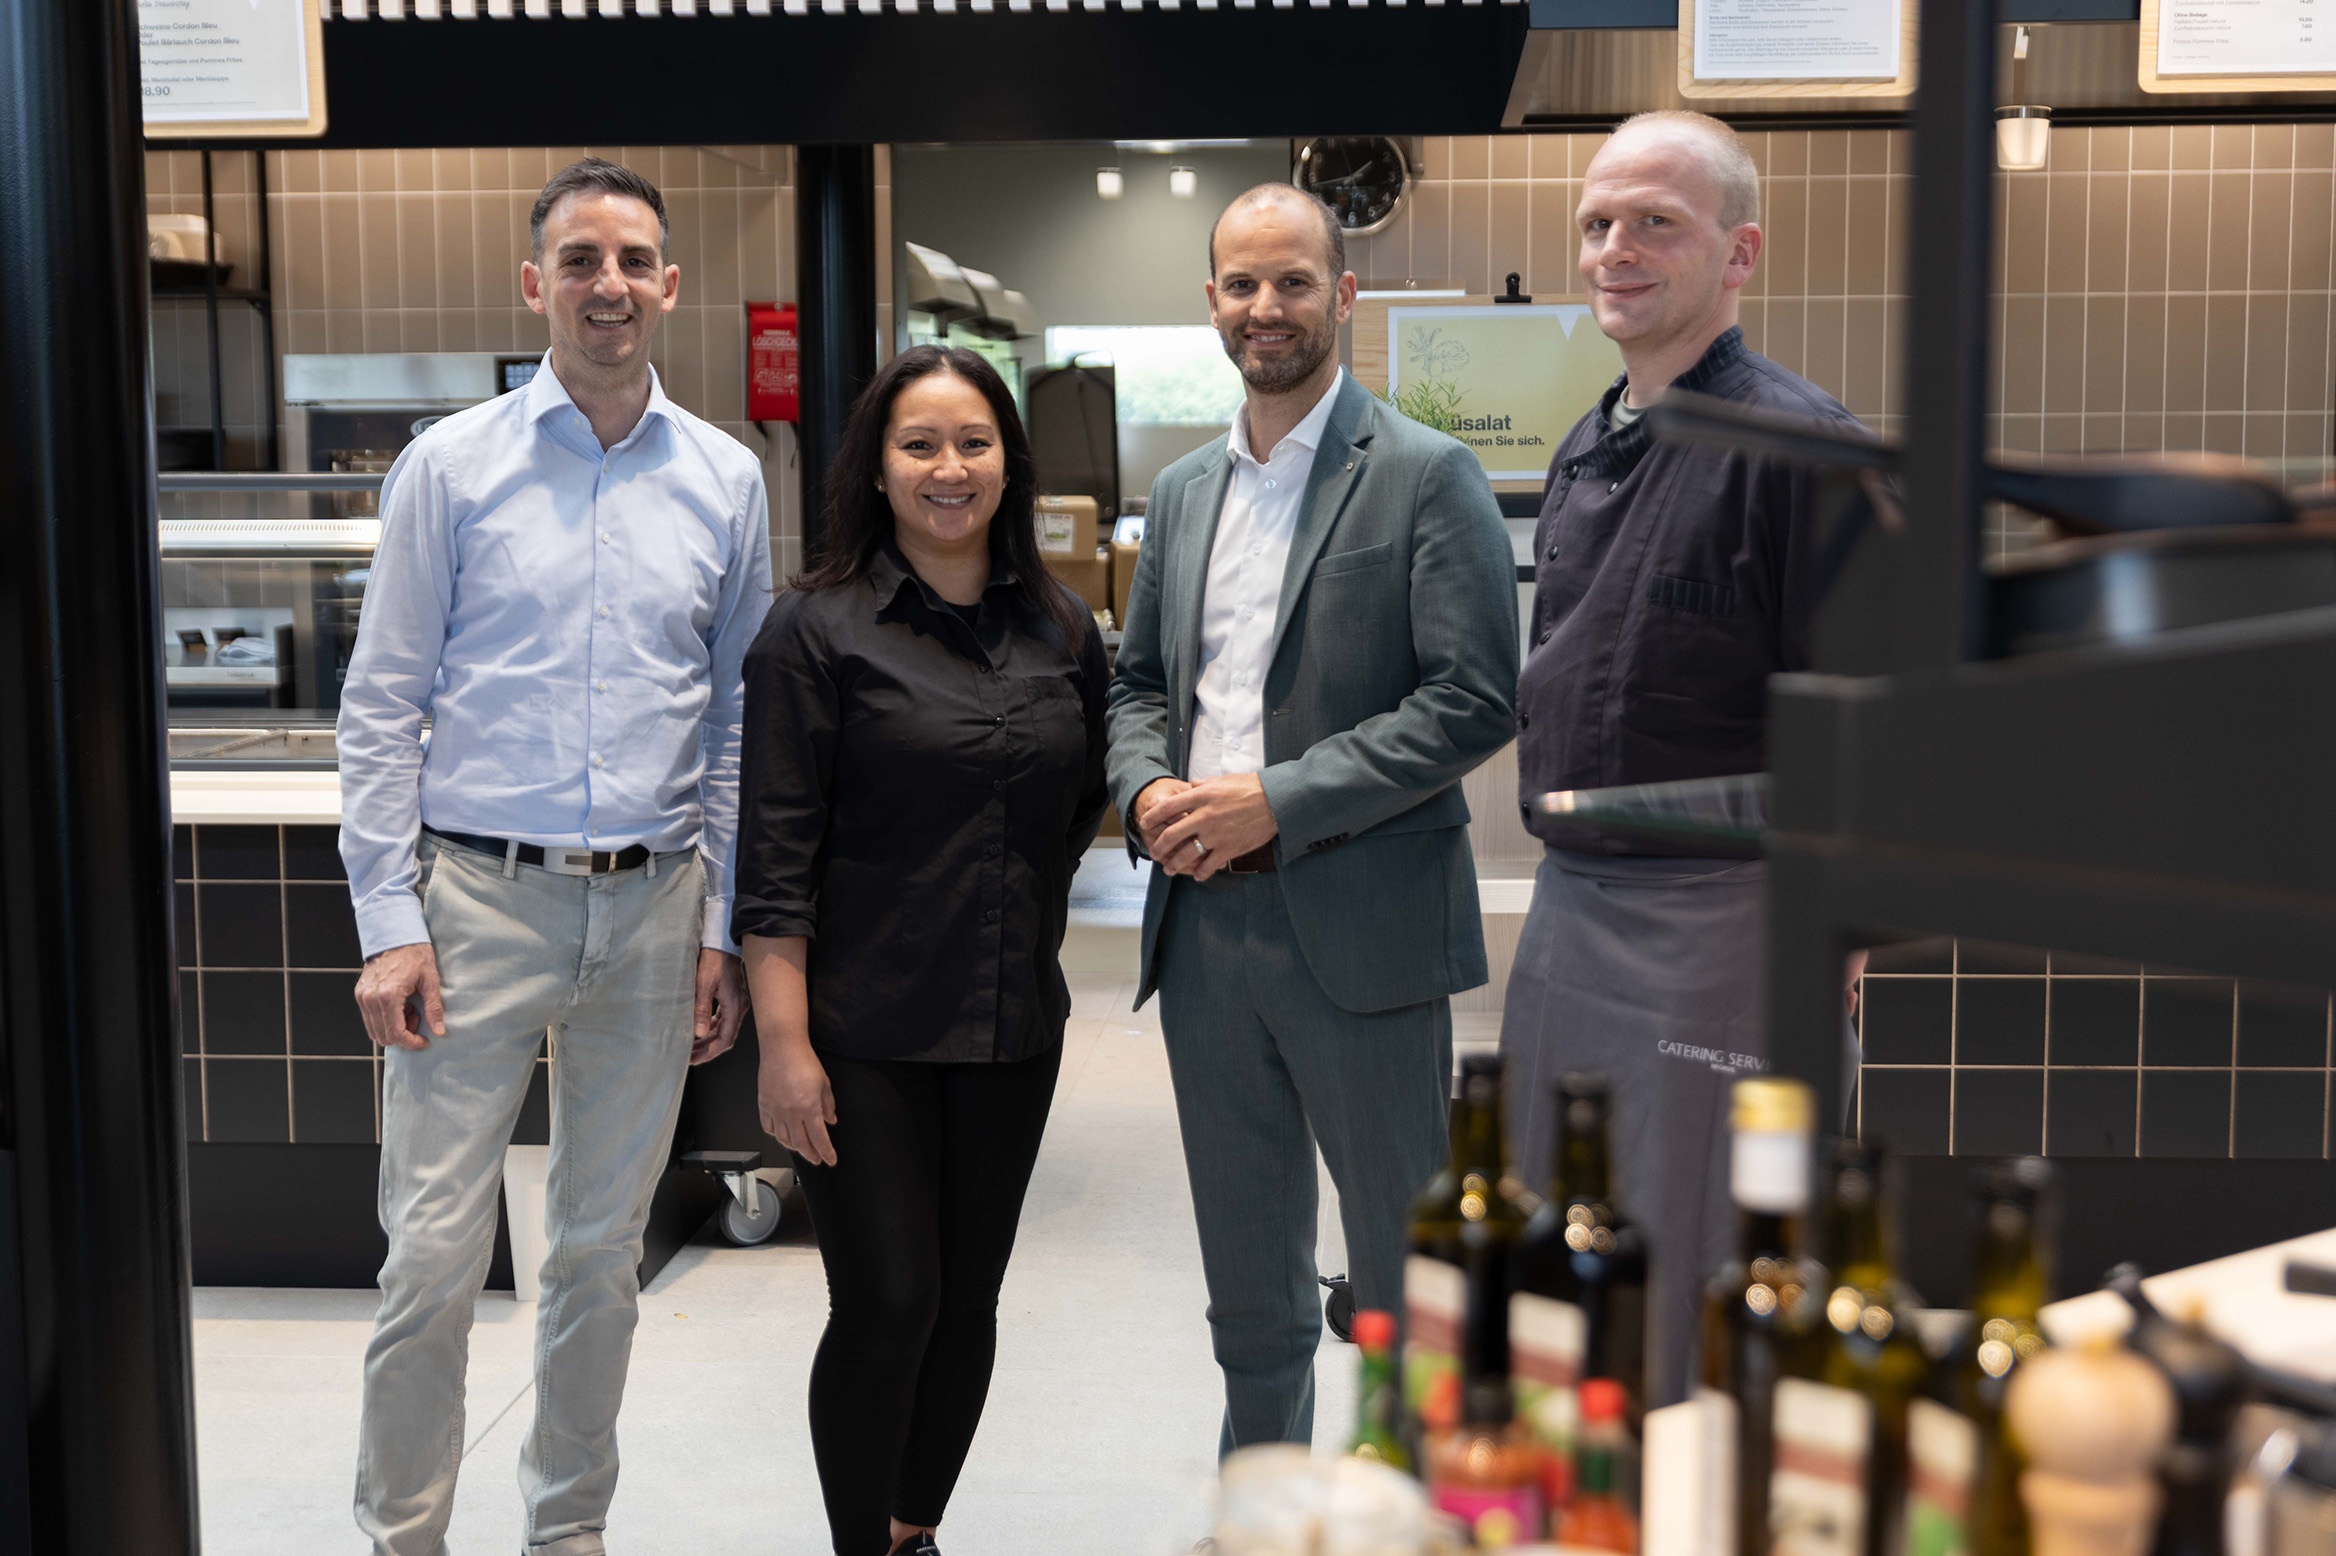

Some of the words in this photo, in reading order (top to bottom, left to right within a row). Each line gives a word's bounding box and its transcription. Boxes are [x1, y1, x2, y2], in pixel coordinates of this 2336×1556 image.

[140, 22, 200, 30] chweins-Cordon
[194, 37, 221, 45] Cordon
[752, 335, 798, 346] LÖSCHDECK
[1450, 414, 1512, 431] üsalat
[1496, 435, 1514, 446] Sie
[1517, 435, 1545, 446] sich.
[1658, 1039, 1724, 1062] CATERING
